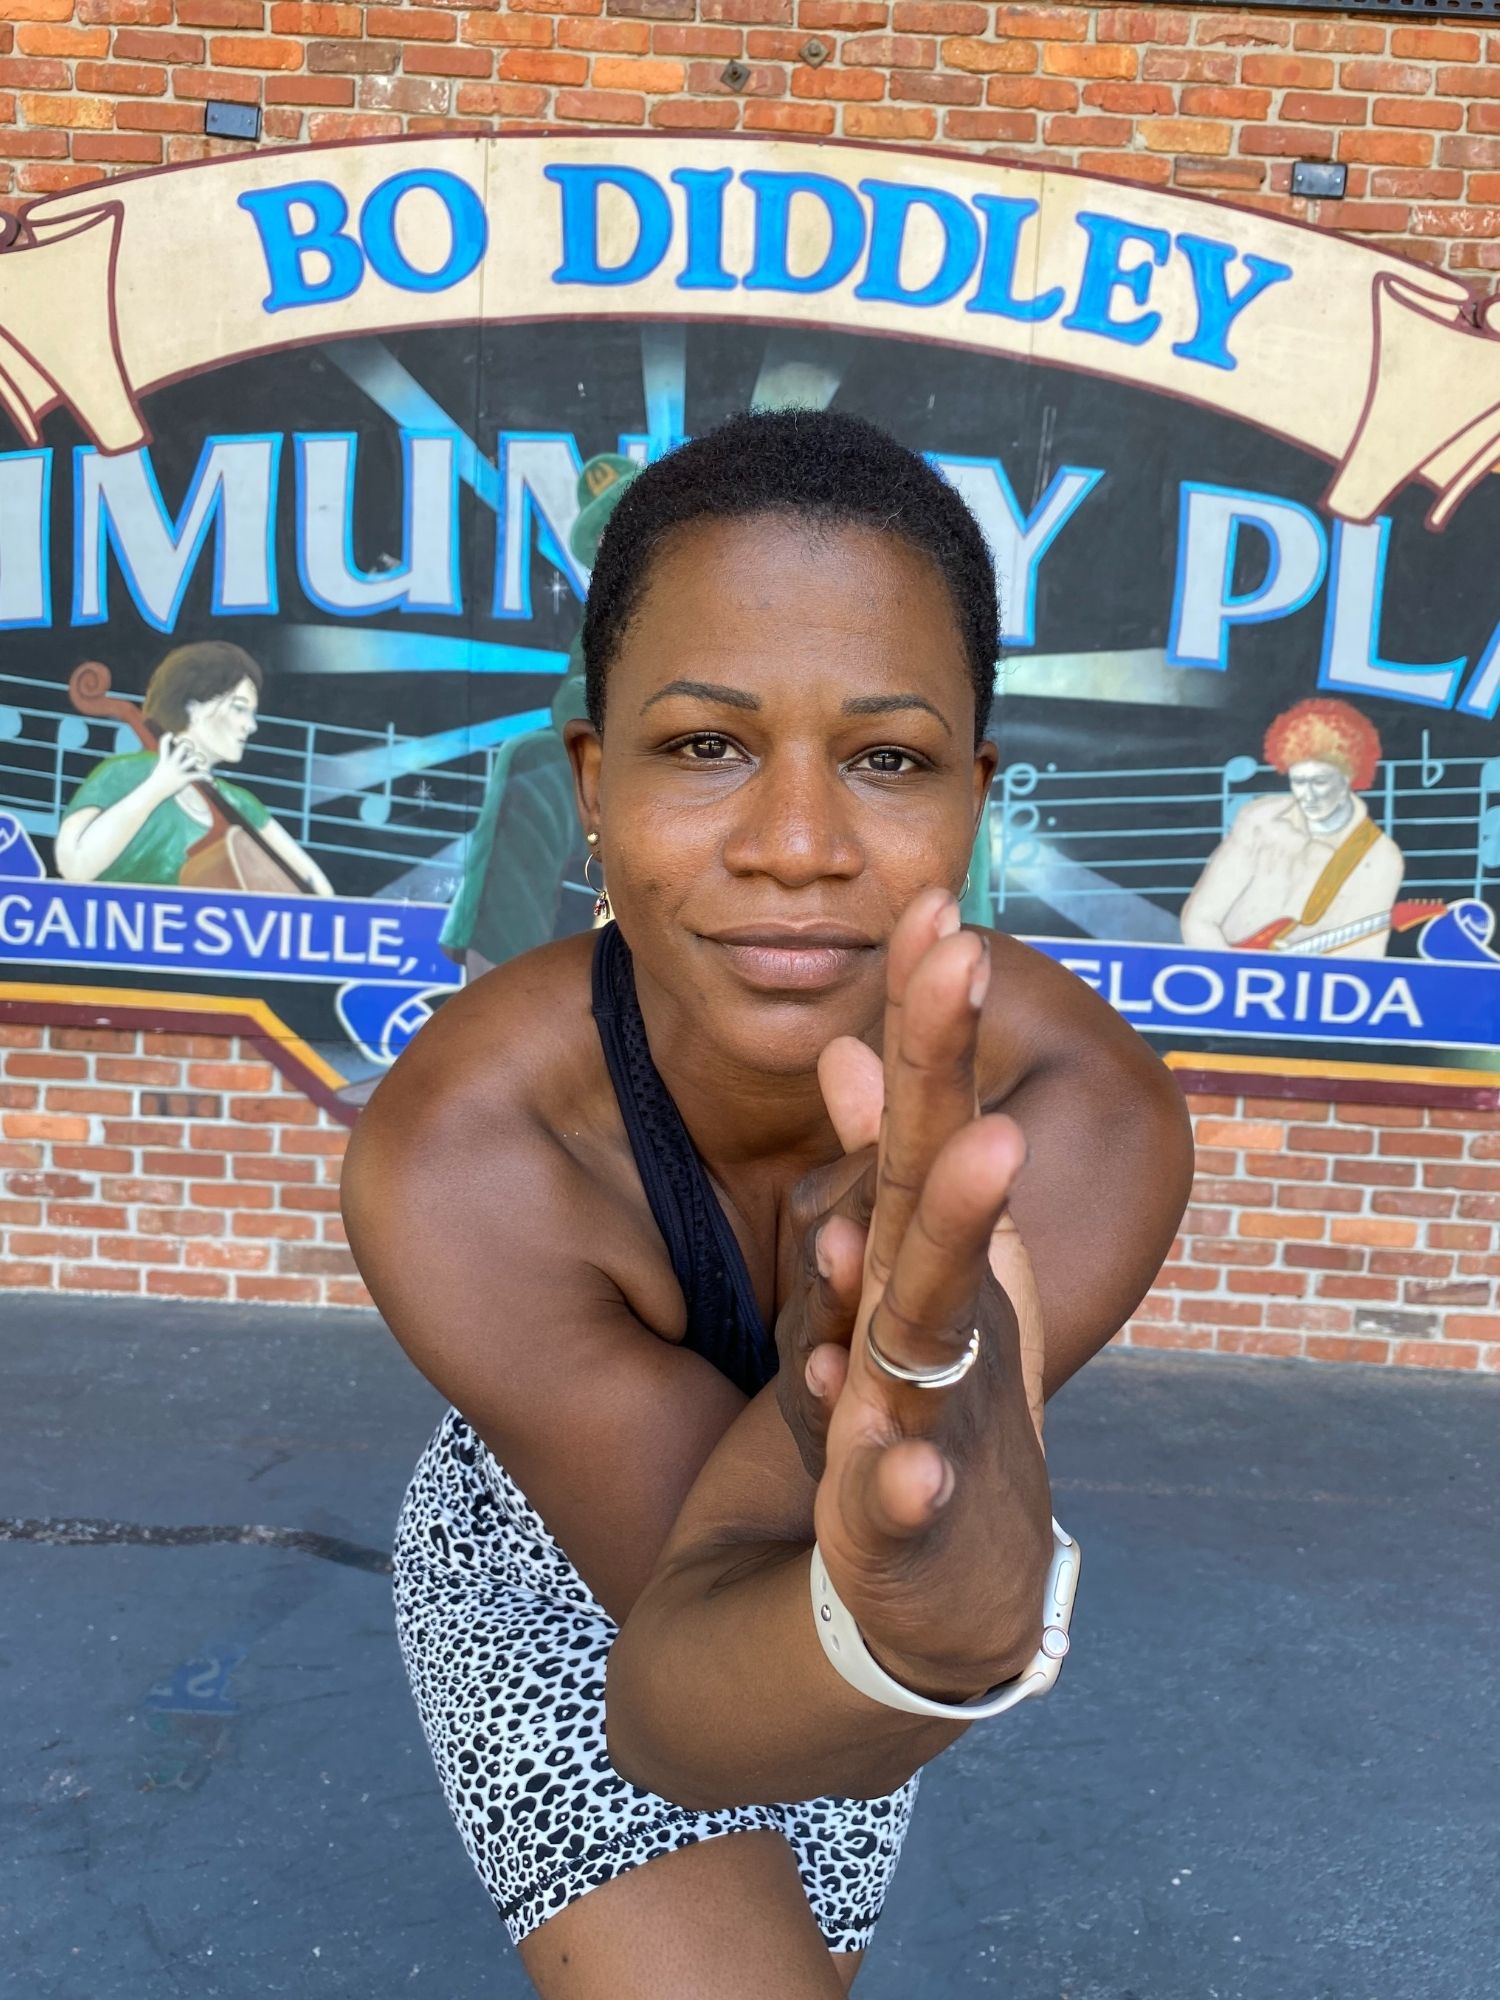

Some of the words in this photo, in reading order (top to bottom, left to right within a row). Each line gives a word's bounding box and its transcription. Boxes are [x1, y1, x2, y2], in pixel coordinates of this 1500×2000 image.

[237, 168, 488, 313] BO
[543, 163, 1293, 371] DIDDLEY
[1166, 480, 1500, 720] PL
[0, 893, 418, 976] GAINESVILLE,
